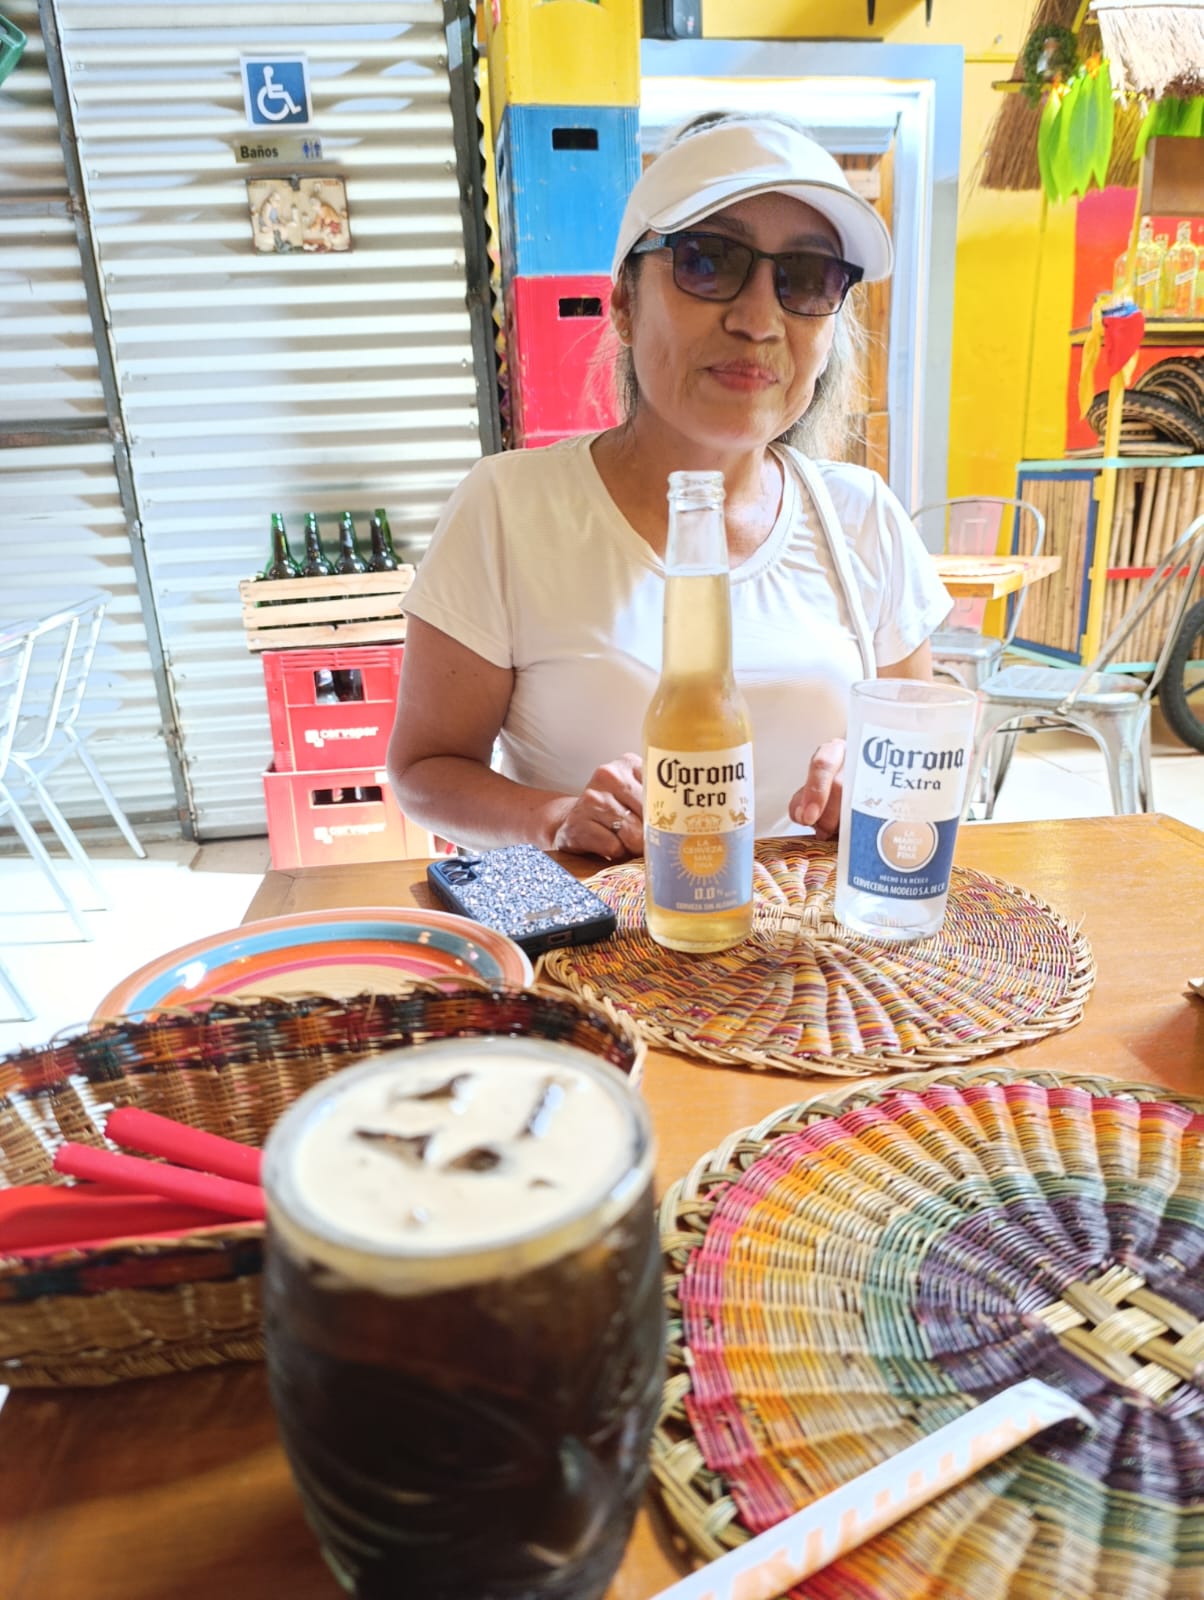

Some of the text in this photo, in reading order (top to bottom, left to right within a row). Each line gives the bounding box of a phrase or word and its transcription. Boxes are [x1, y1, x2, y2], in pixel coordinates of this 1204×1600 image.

[240, 145, 279, 159] Baños
[862, 736, 964, 774] Corona
[656, 758, 745, 793] Corona
[891, 771, 942, 790] Extra
[683, 787, 726, 807] Cero
[889, 886, 918, 896] MODELO
